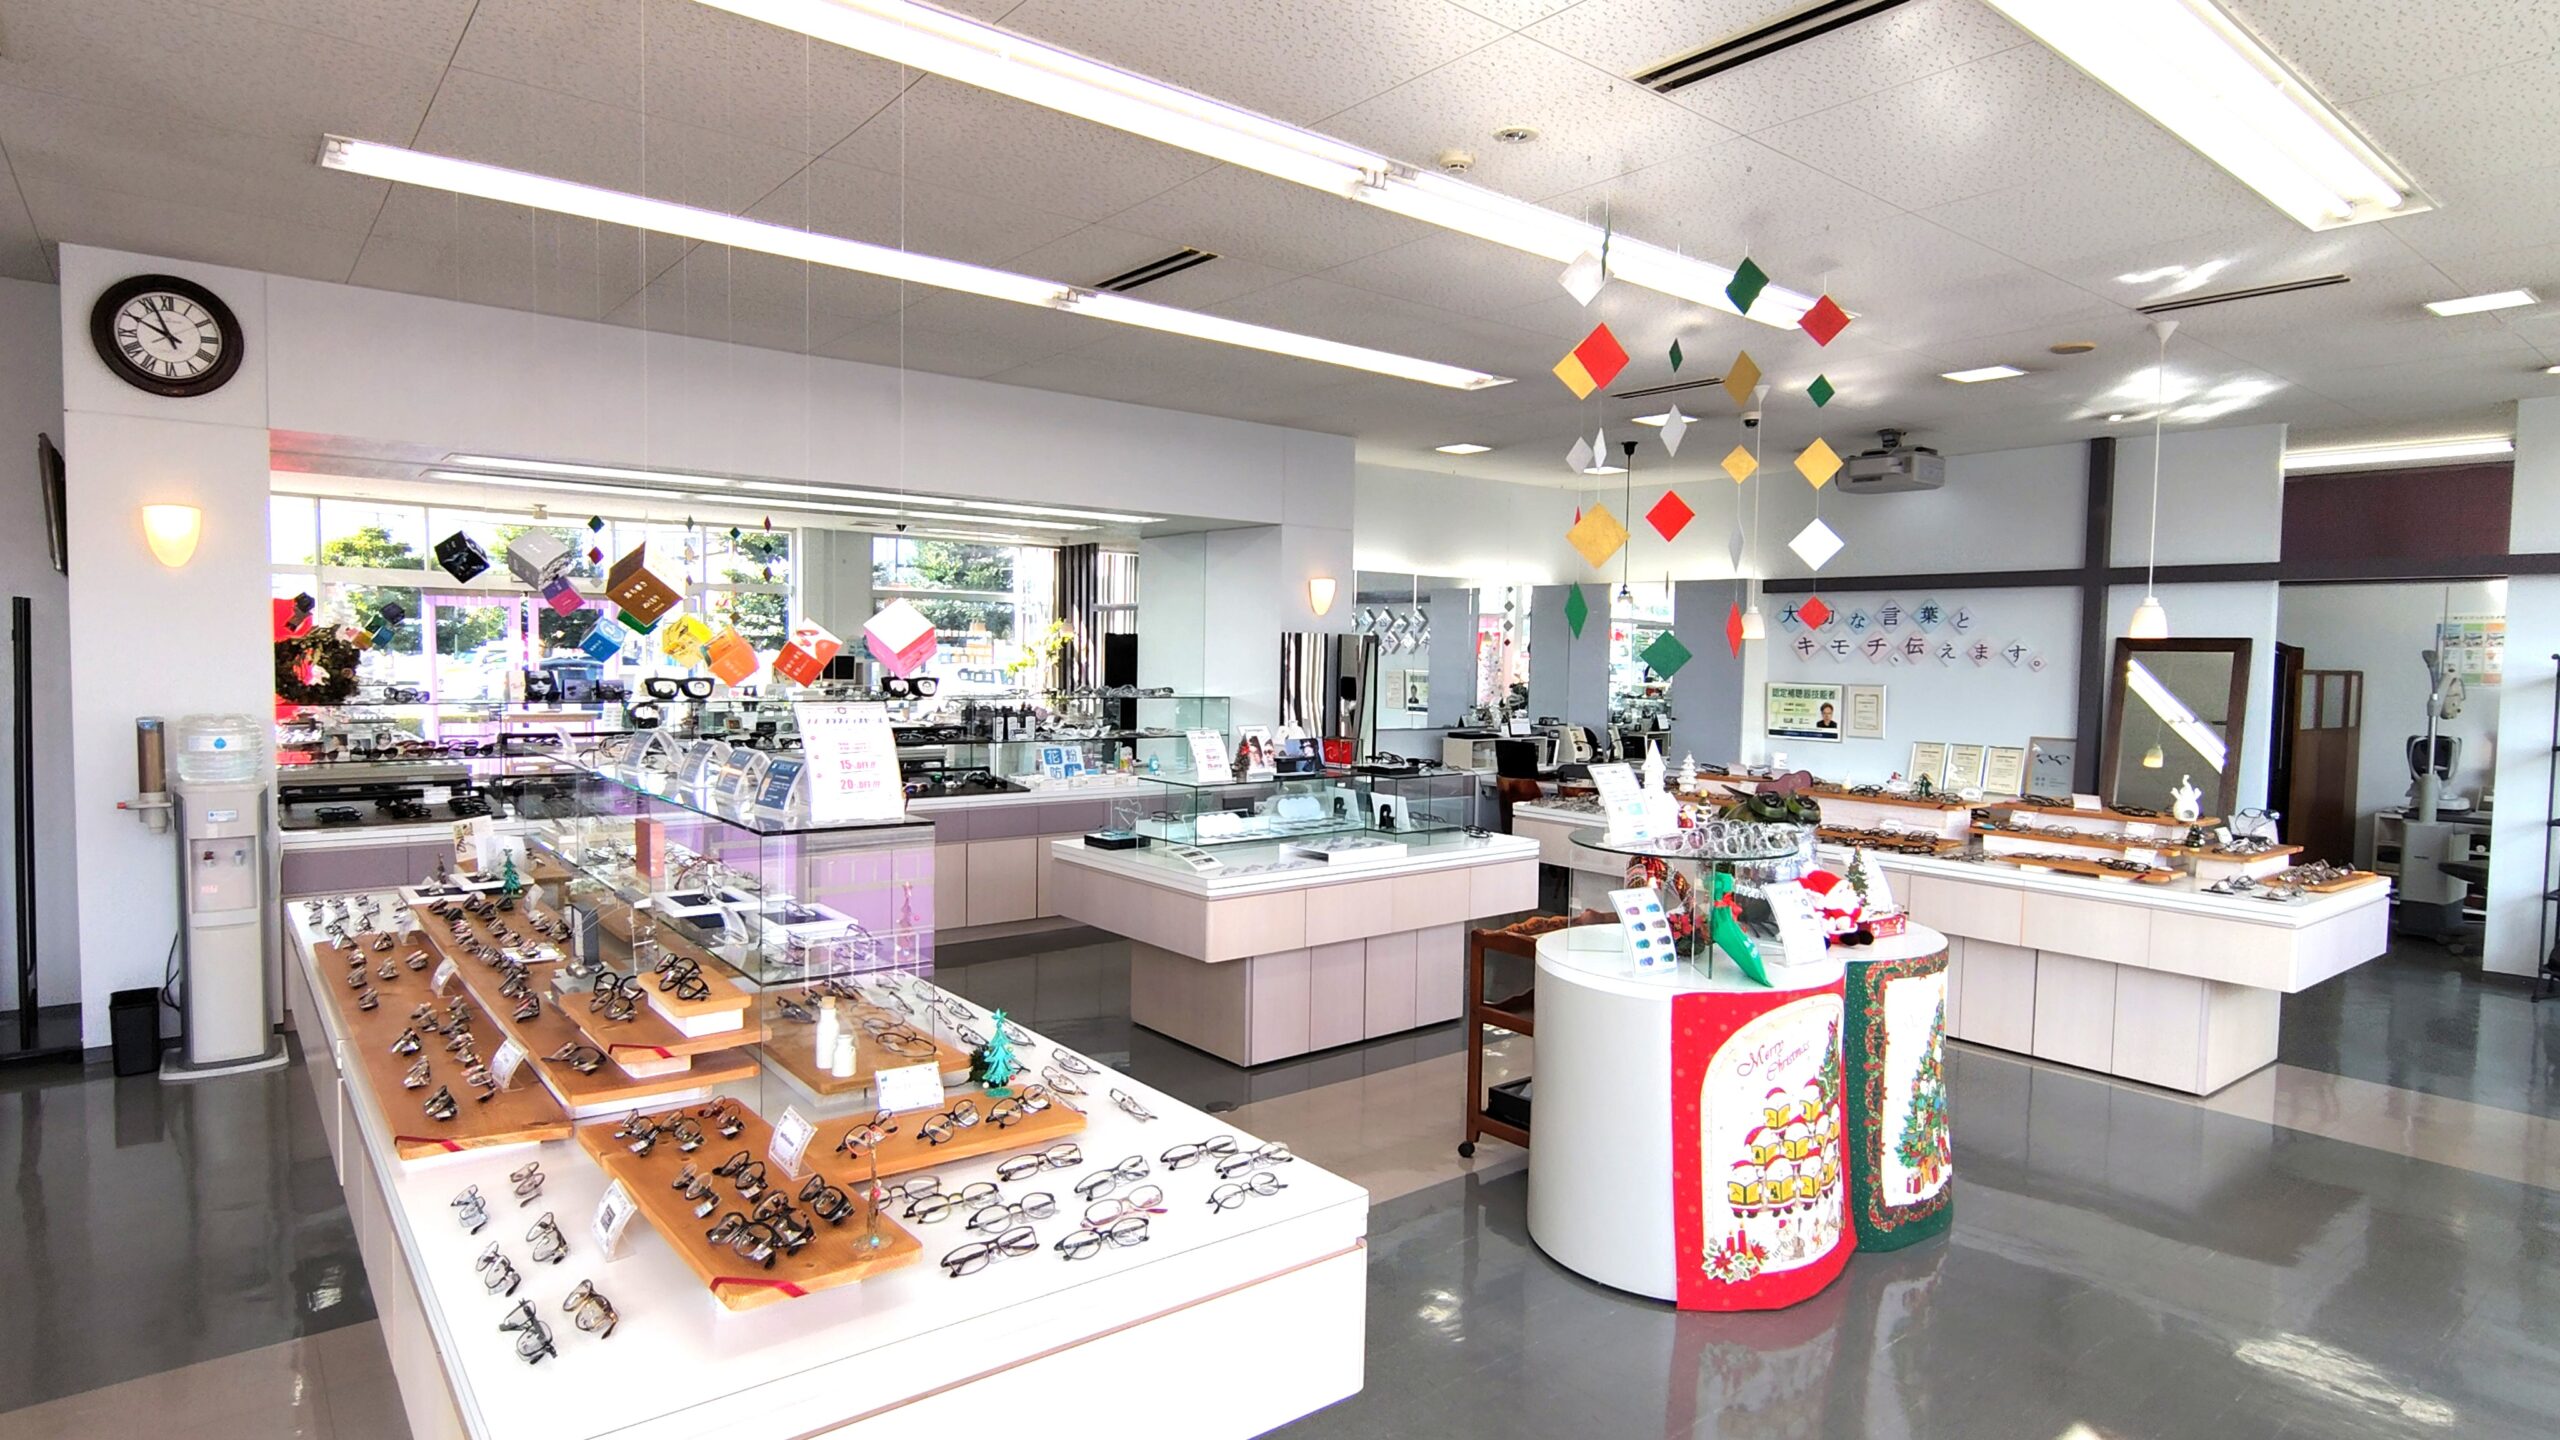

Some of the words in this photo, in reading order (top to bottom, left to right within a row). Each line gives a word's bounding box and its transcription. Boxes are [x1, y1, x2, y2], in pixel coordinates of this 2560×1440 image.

[160, 295, 175, 312] XII
[194, 318, 212, 329] II
[117, 327, 138, 338] IX
[200, 335, 219, 345] III
[164, 361, 178, 377] VI
[185, 360, 200, 375] V
[1796, 636, 2042, 668] キモチ、伝えます。
[1736, 1040, 1785, 1077] Merry
